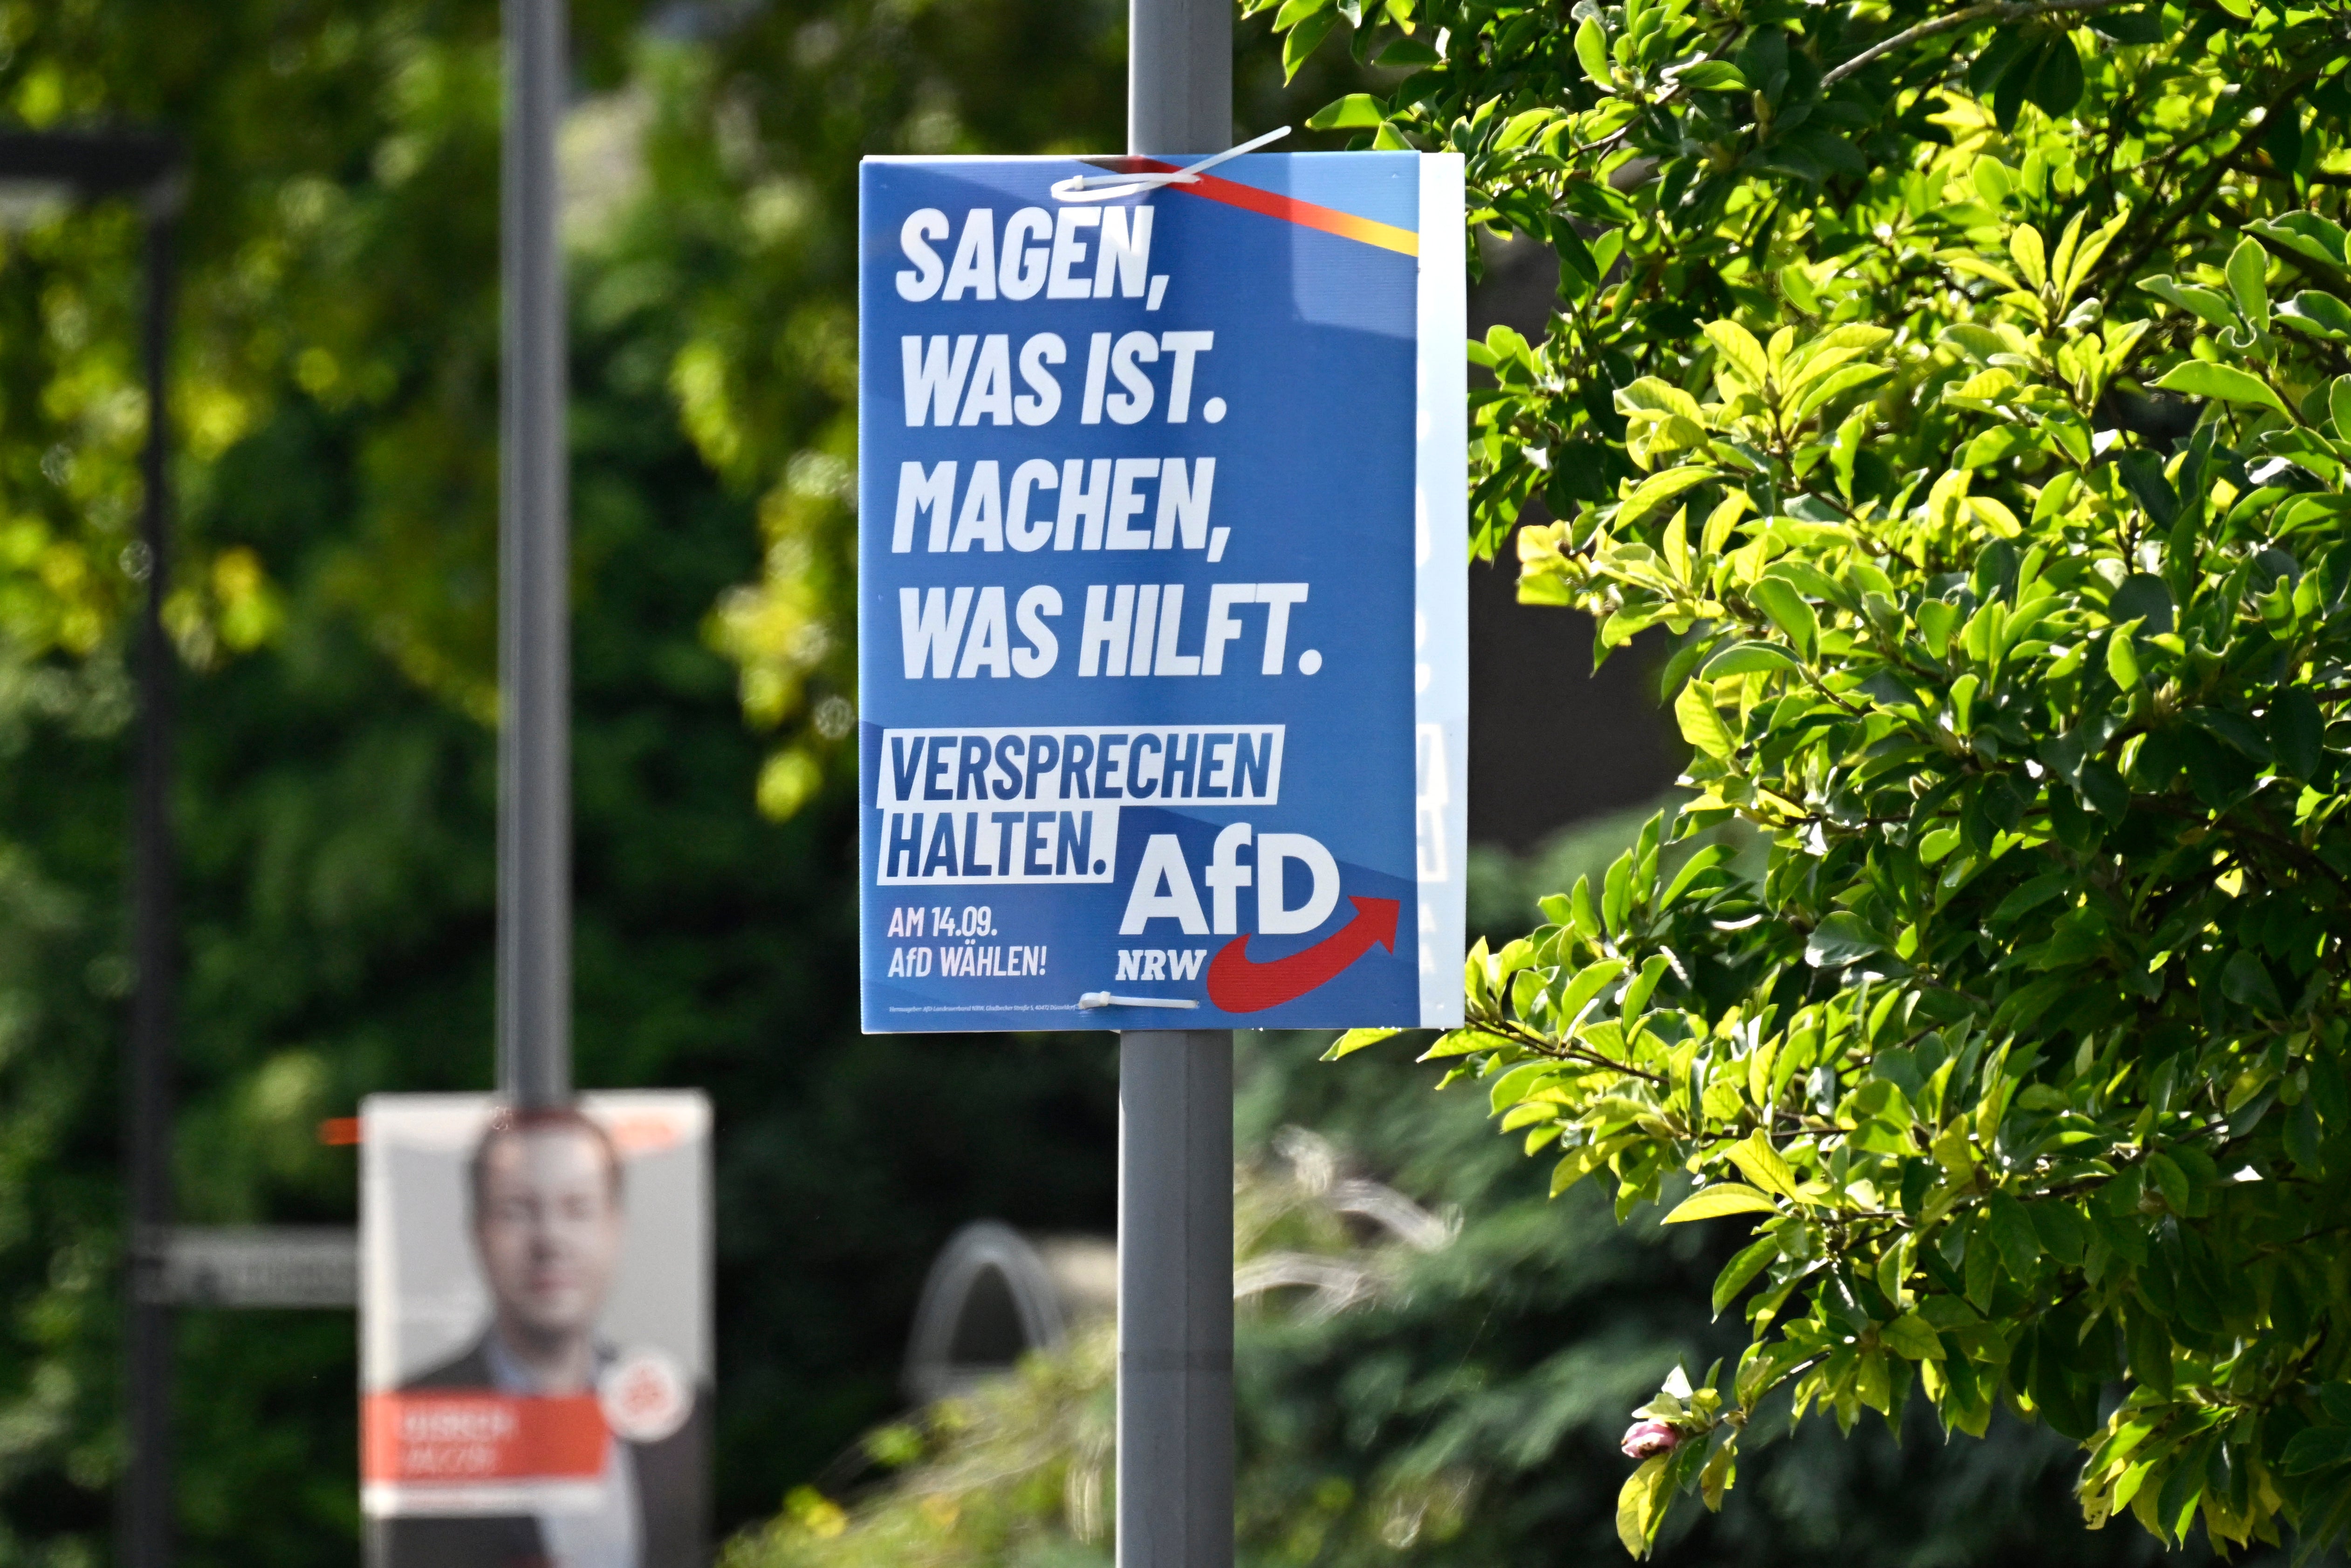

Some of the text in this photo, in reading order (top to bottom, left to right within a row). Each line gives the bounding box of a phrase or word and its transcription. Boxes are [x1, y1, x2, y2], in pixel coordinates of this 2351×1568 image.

[895, 205, 1170, 311] SAGEN,
[901, 330, 1227, 427] WAS IST.
[891, 457, 1231, 562] MACHEN,
[899, 582, 1323, 679] WAS HILFT.
[890, 731, 1275, 802] VERSPRECHEN
[885, 809, 1108, 879] HALTEN.
[1117, 822, 1340, 936] AfD
[887, 906, 998, 938] AM 14.09.
[887, 938, 1048, 979] AfD WÄHLEN!
[1116, 949, 1207, 981] NRW
